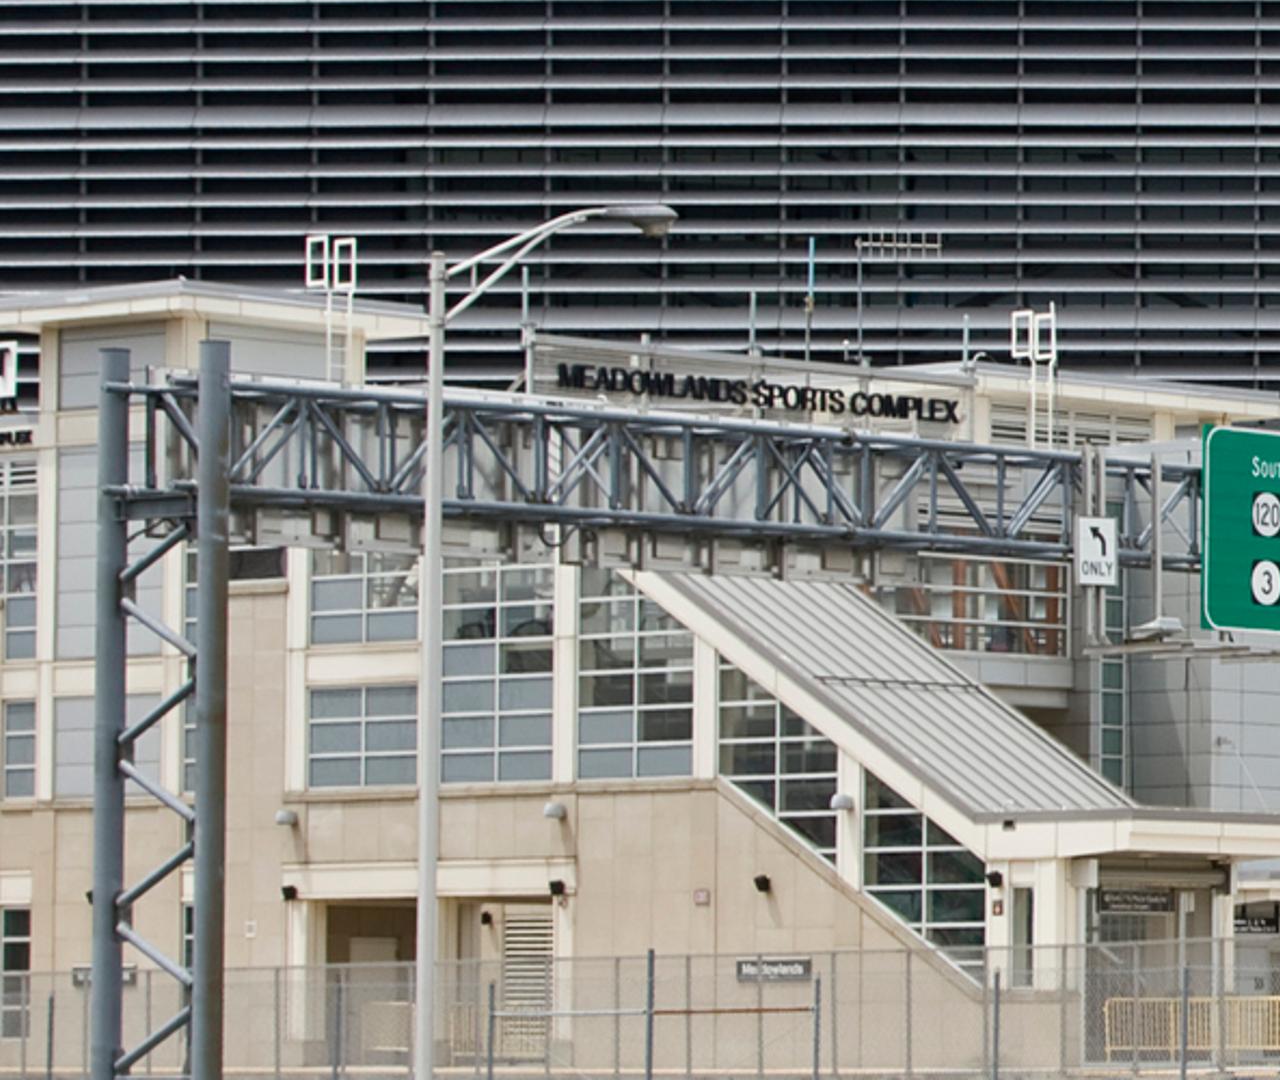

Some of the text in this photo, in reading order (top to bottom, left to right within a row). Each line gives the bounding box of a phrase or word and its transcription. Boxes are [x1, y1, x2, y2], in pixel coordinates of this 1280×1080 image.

[557, 362, 961, 424] MEADOWLANDS SPORTS COMPLEX
[1255, 501, 1280, 528] 120
[1081, 560, 1112, 577] ONLY
[1261, 570, 1274, 595] 3
